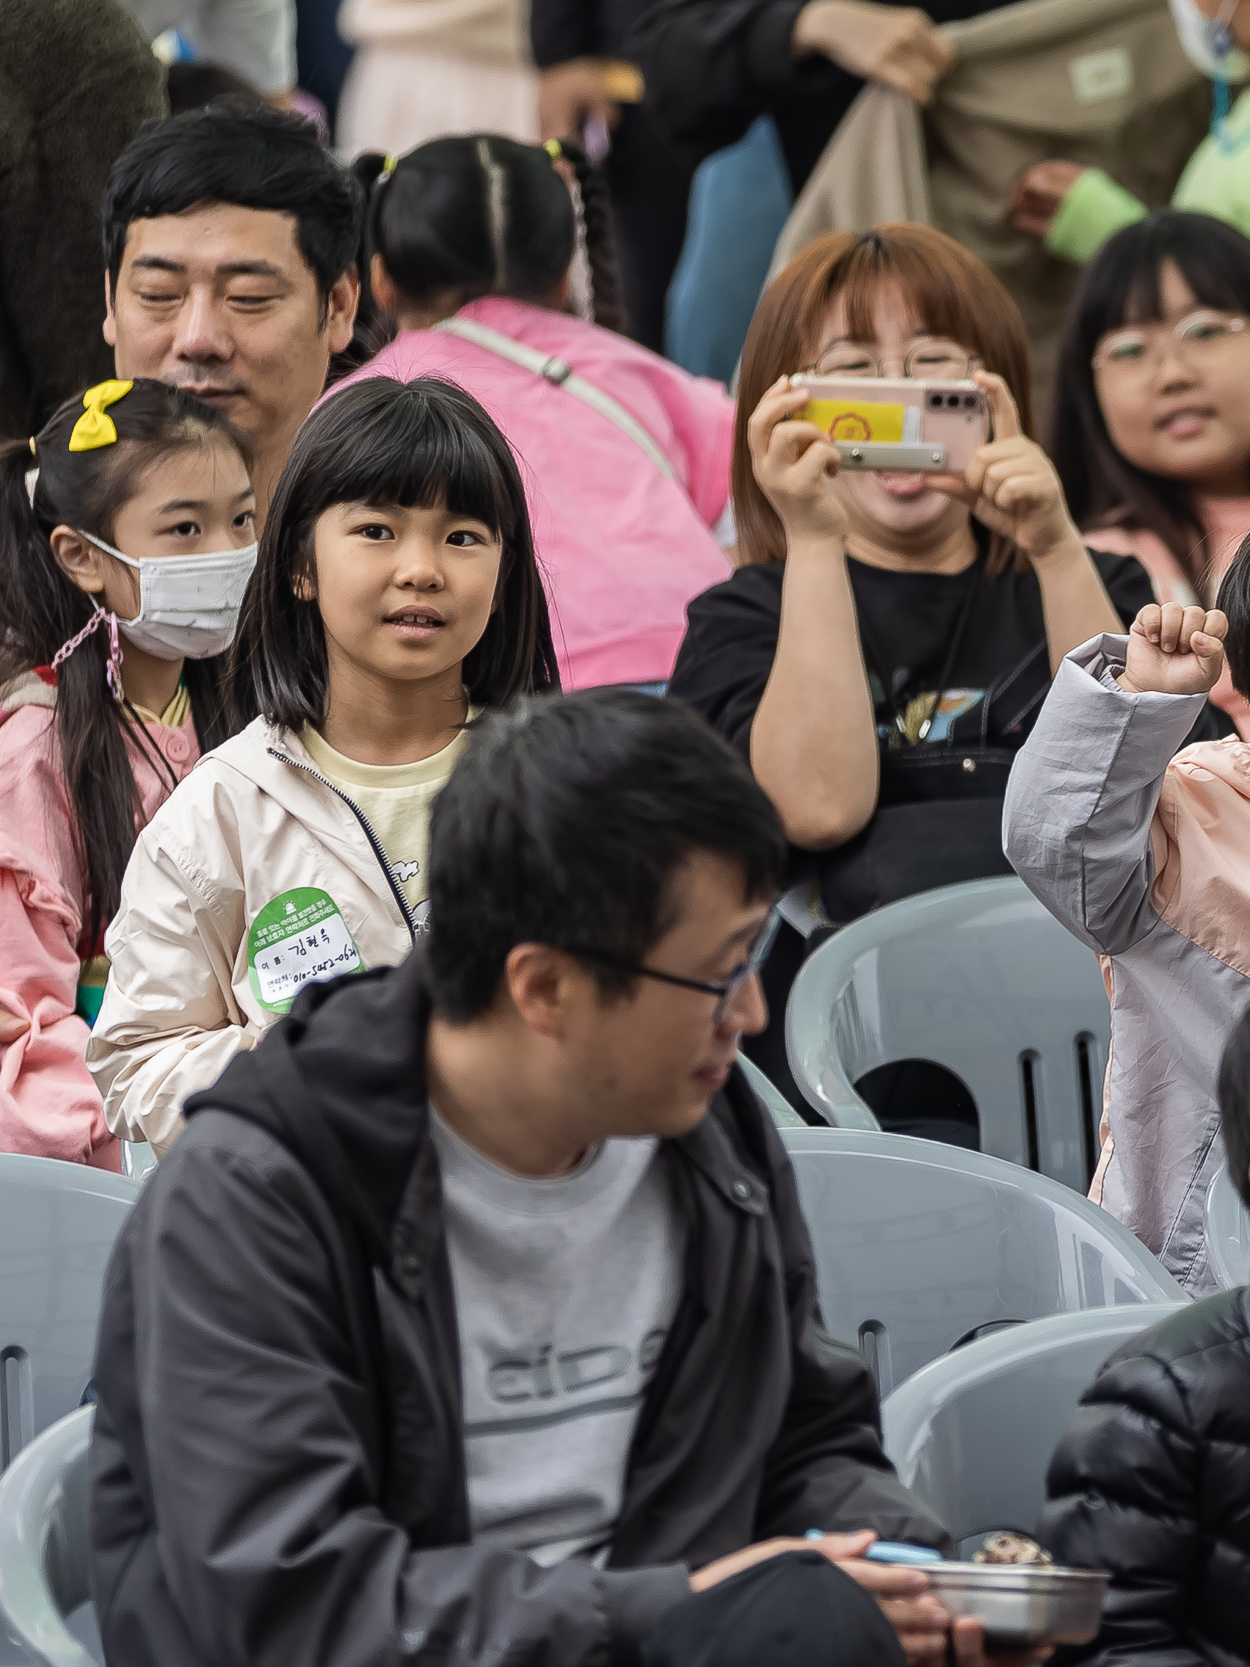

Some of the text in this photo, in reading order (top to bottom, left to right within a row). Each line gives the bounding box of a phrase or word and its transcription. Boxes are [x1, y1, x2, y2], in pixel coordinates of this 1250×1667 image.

[253, 904, 335, 948] 아래 보호자 연락처로 전화주세요
[280, 914, 298, 926] 아이를
[316, 898, 327, 909] 경우
